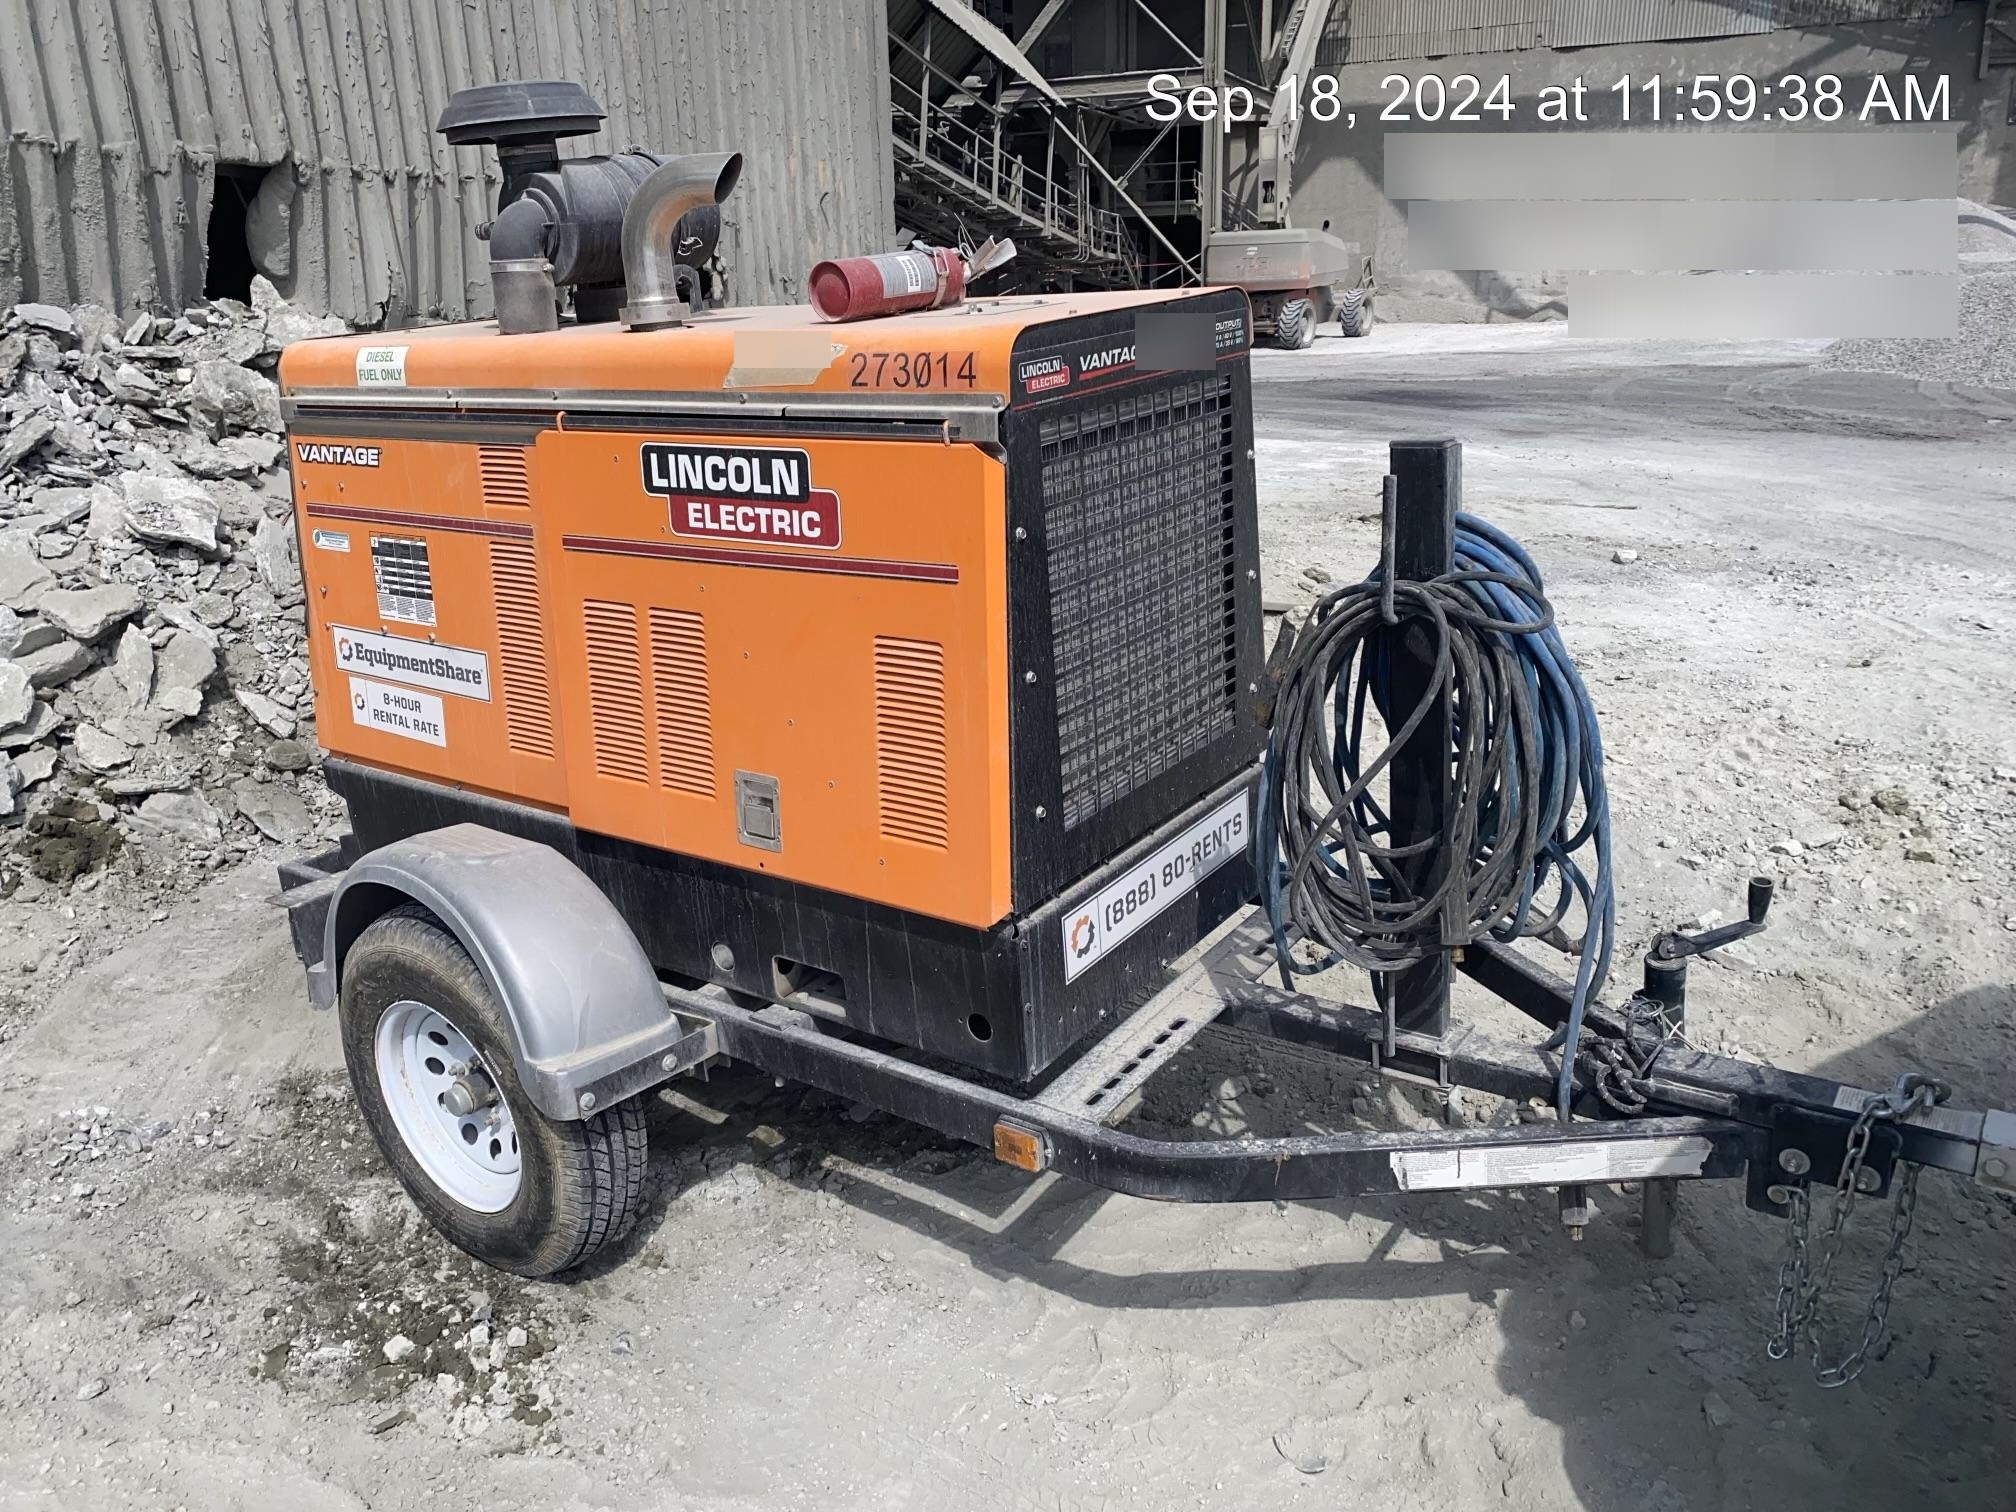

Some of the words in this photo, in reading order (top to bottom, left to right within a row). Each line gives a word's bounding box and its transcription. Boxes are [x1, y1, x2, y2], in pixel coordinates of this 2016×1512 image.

[365, 351, 395, 363] DIESEL
[850, 351, 977, 389] 273014
[1021, 359, 1061, 379] LINCOLN
[358, 368, 380, 381] FUEL
[380, 368, 402, 381] ONLY
[1031, 374, 1066, 390] ELECTRIC
[296, 443, 380, 467] VANTAGE
[649, 452, 801, 497] LINCOLN
[687, 502, 822, 539] ELECTRIC
[354, 642, 483, 686] EquipmentShare
[382, 692, 422, 714] 8-HOUR
[372, 708, 411, 730] RENTAL
[413, 719, 440, 737] RATE
[1104, 872, 1157, 932] (888)
[1161, 812, 1243, 889] 80-RENTS
